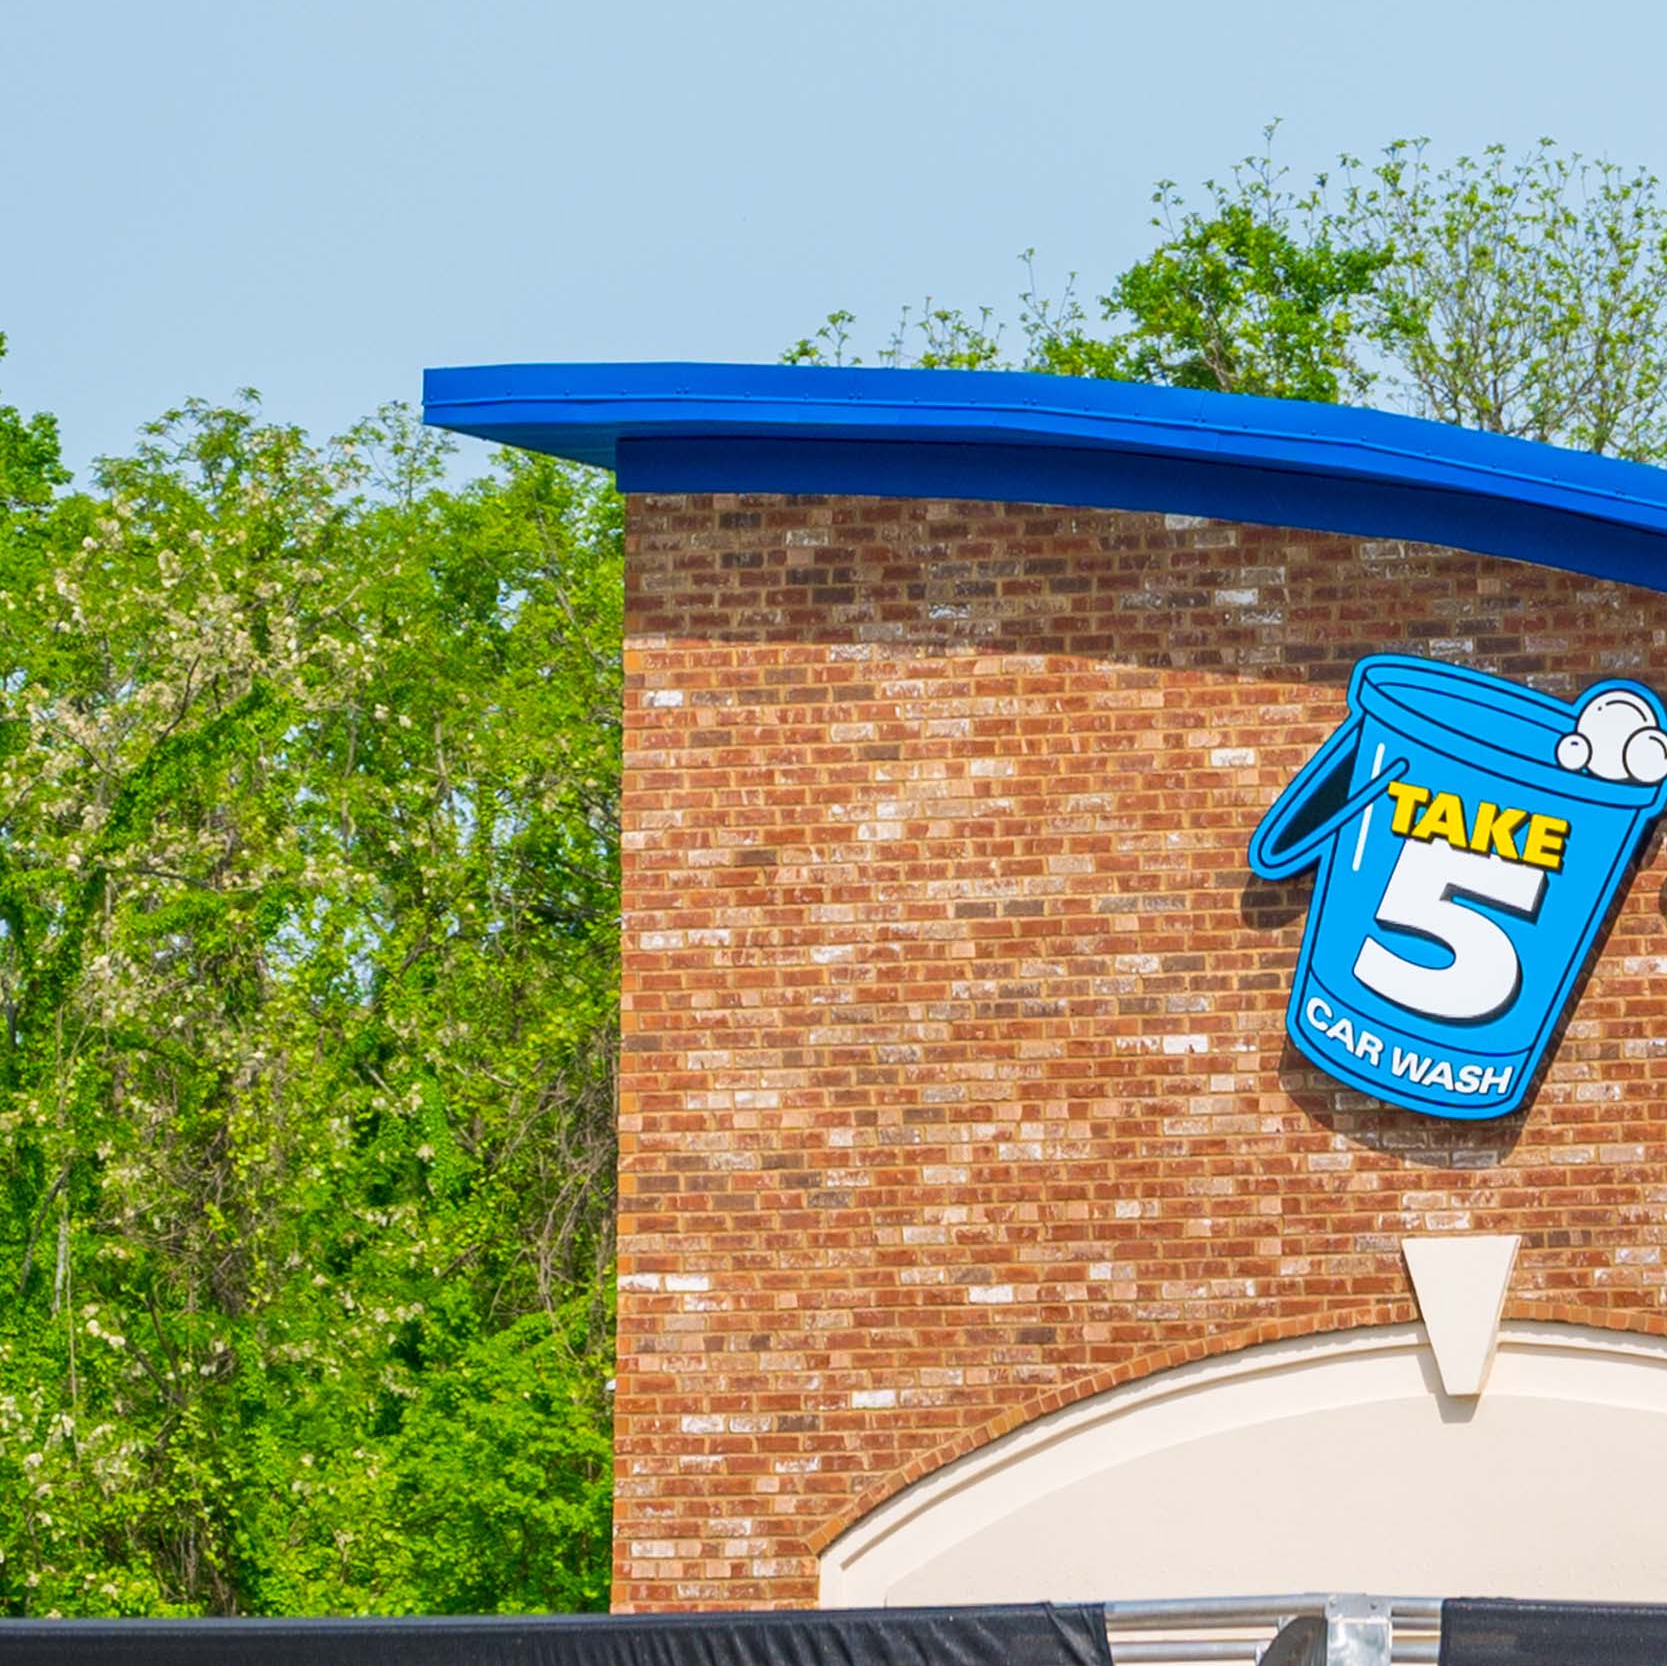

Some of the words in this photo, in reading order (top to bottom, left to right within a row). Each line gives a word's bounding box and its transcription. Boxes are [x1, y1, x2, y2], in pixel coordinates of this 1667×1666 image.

[1388, 781, 1570, 870] TAKE
[1352, 838, 1549, 1023] 5
[1306, 997, 1384, 1066] CAR
[1392, 1046, 1514, 1096] WASH
